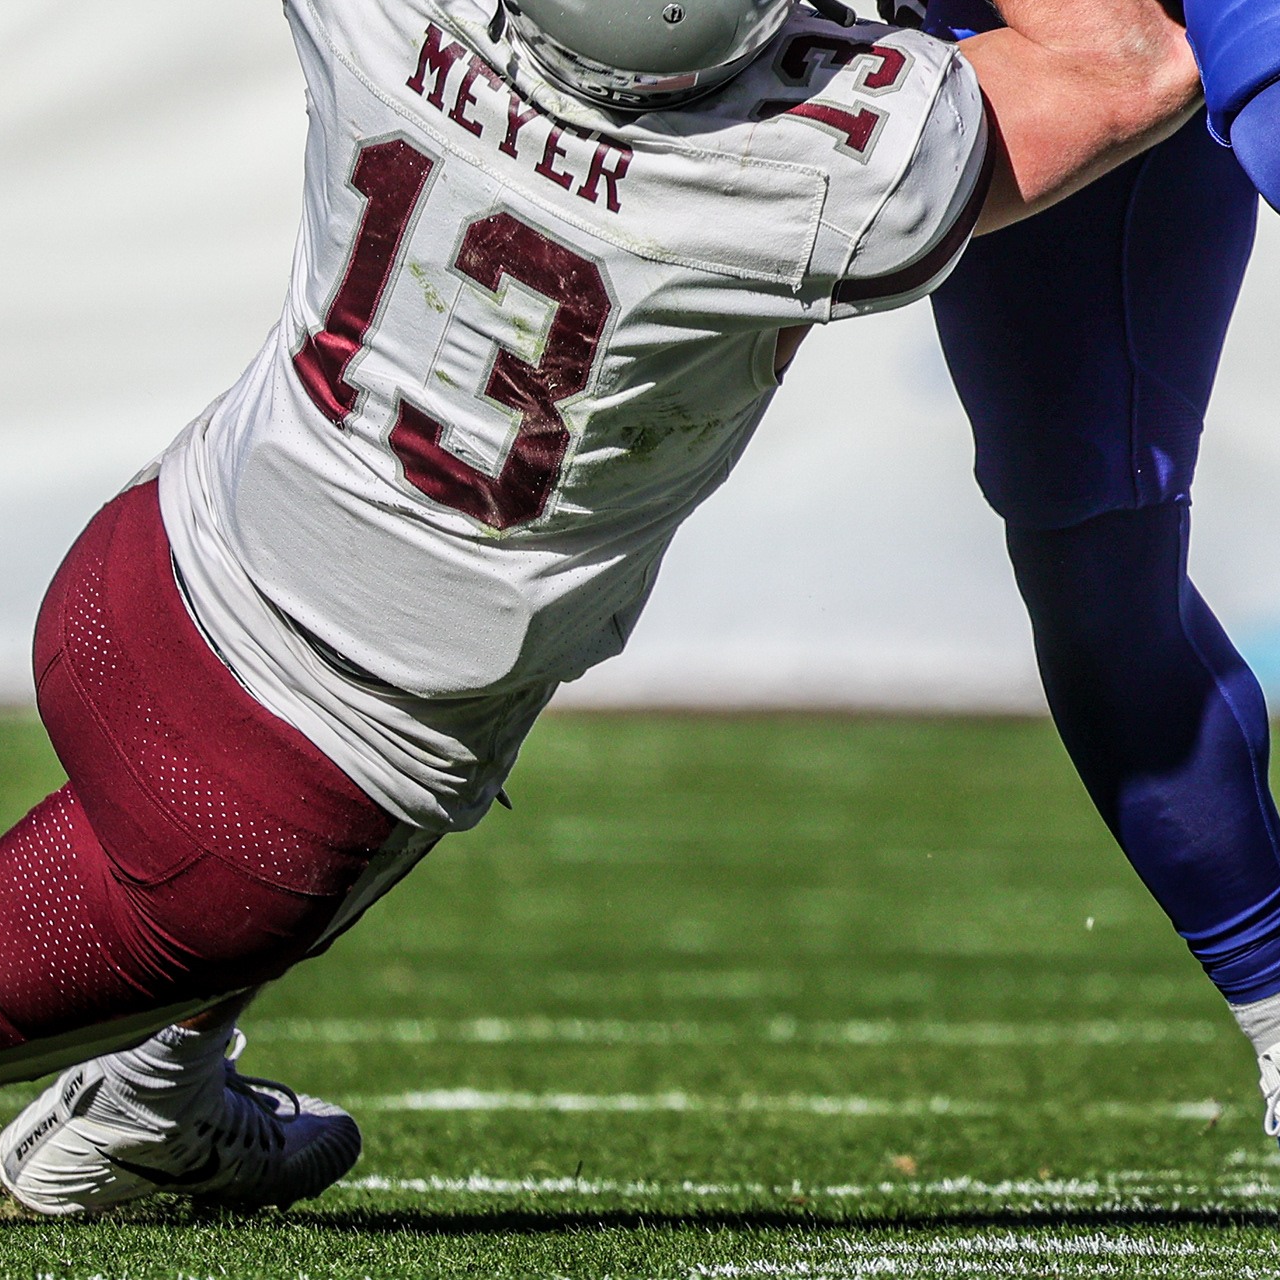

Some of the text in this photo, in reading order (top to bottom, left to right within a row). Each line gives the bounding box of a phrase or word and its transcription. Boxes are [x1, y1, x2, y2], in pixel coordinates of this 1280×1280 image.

[406, 22, 634, 214] MEYER
[289, 128, 622, 541] 13
[17, 1110, 60, 1161] MENACE
